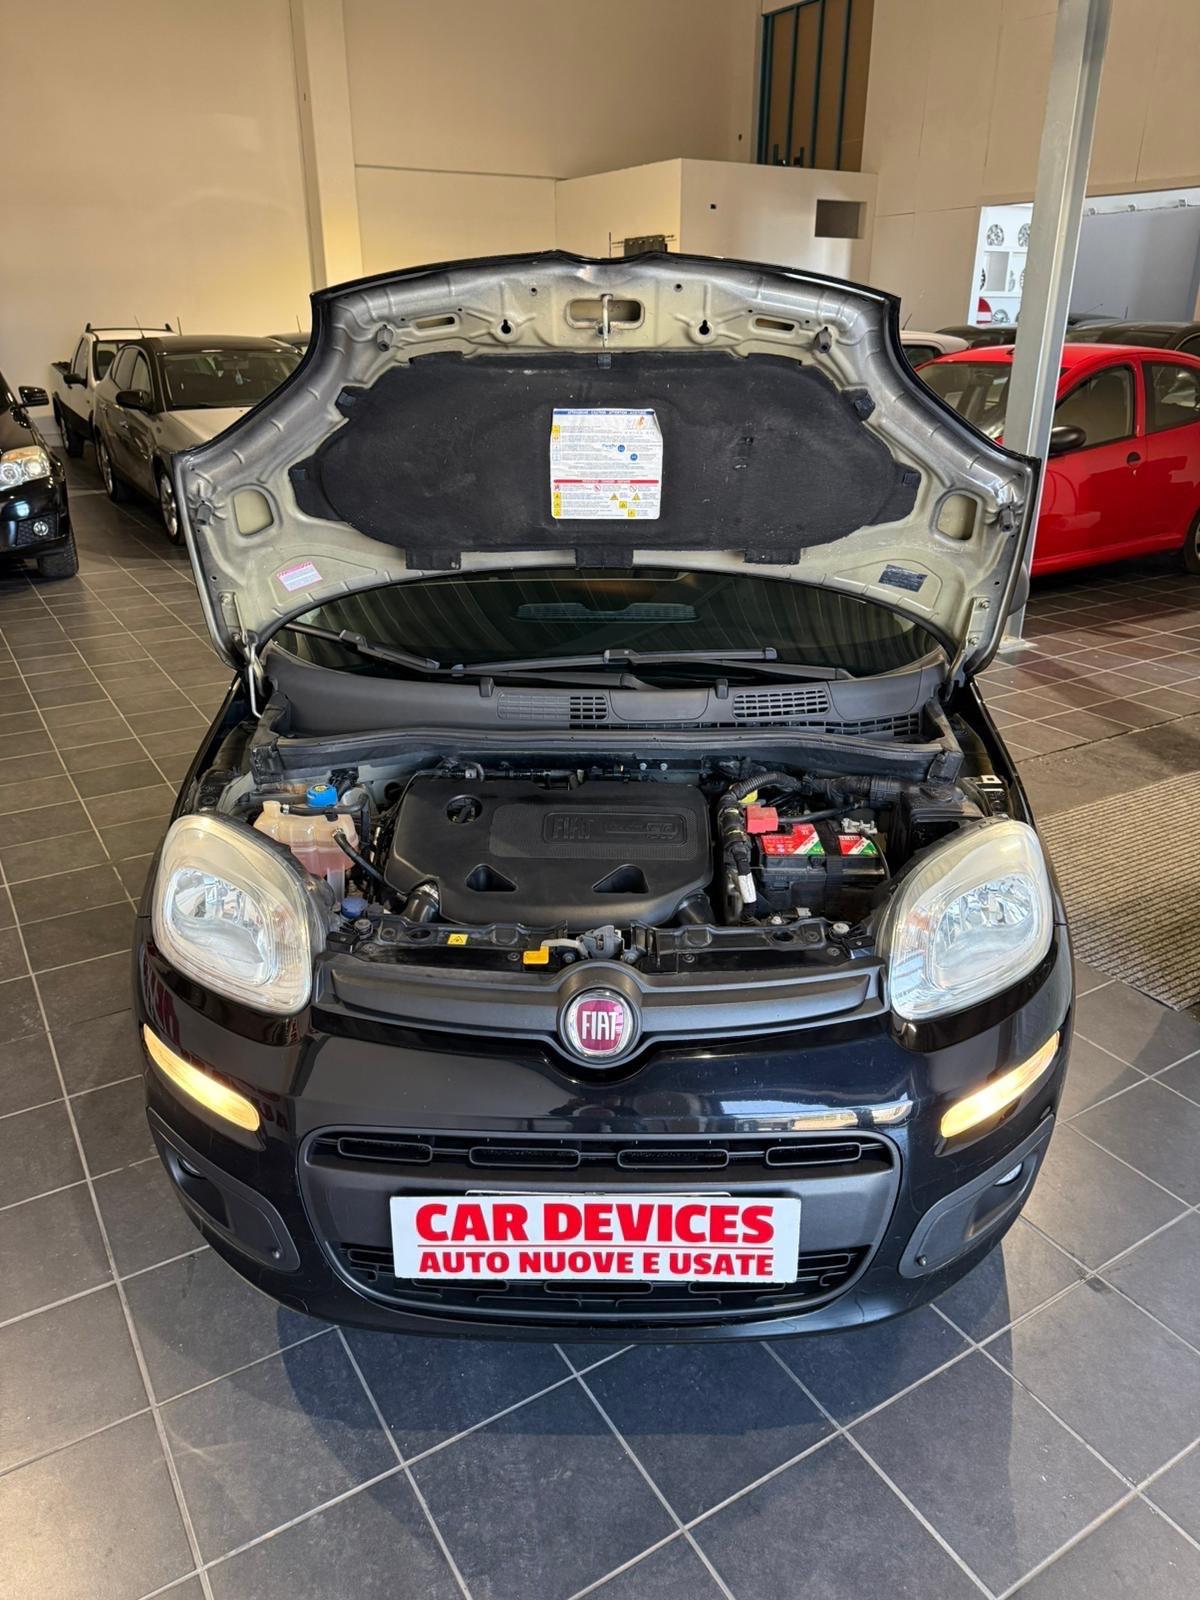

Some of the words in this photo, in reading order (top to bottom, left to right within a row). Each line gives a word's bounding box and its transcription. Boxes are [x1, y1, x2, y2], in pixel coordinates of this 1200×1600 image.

[582, 1011, 618, 1041] FIAT
[416, 1203, 529, 1242] CAR
[543, 1203, 774, 1244] DEVICES
[419, 1251, 510, 1274] AUTO
[518, 1251, 633, 1274] NUOVE
[642, 1252, 659, 1275] E
[668, 1253, 773, 1277] USATE
